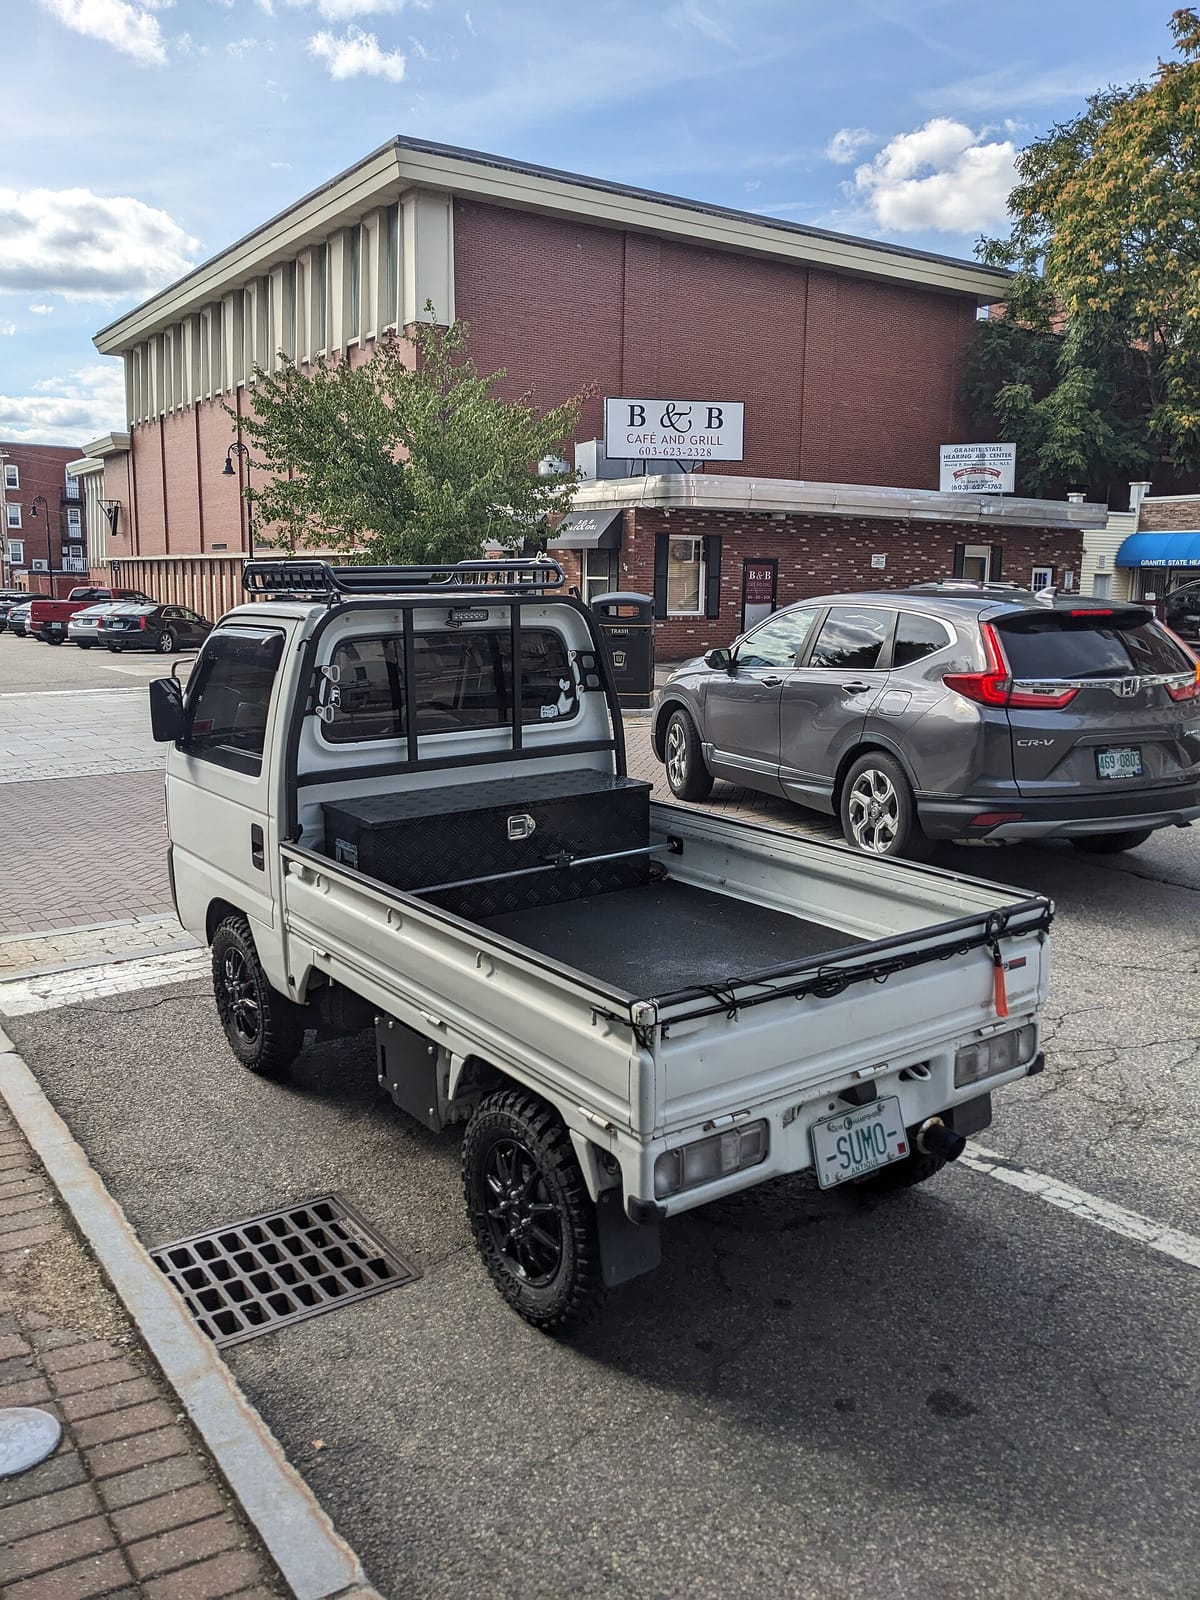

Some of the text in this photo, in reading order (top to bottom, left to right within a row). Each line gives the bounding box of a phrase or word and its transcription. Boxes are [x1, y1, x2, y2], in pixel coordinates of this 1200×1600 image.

[626, 402, 724, 433] B & B
[626, 432, 723, 446] CAFÉ AND GRILL
[638, 446, 712, 457] 603-623-2328
[1016, 739, 1055, 747] CR-V
